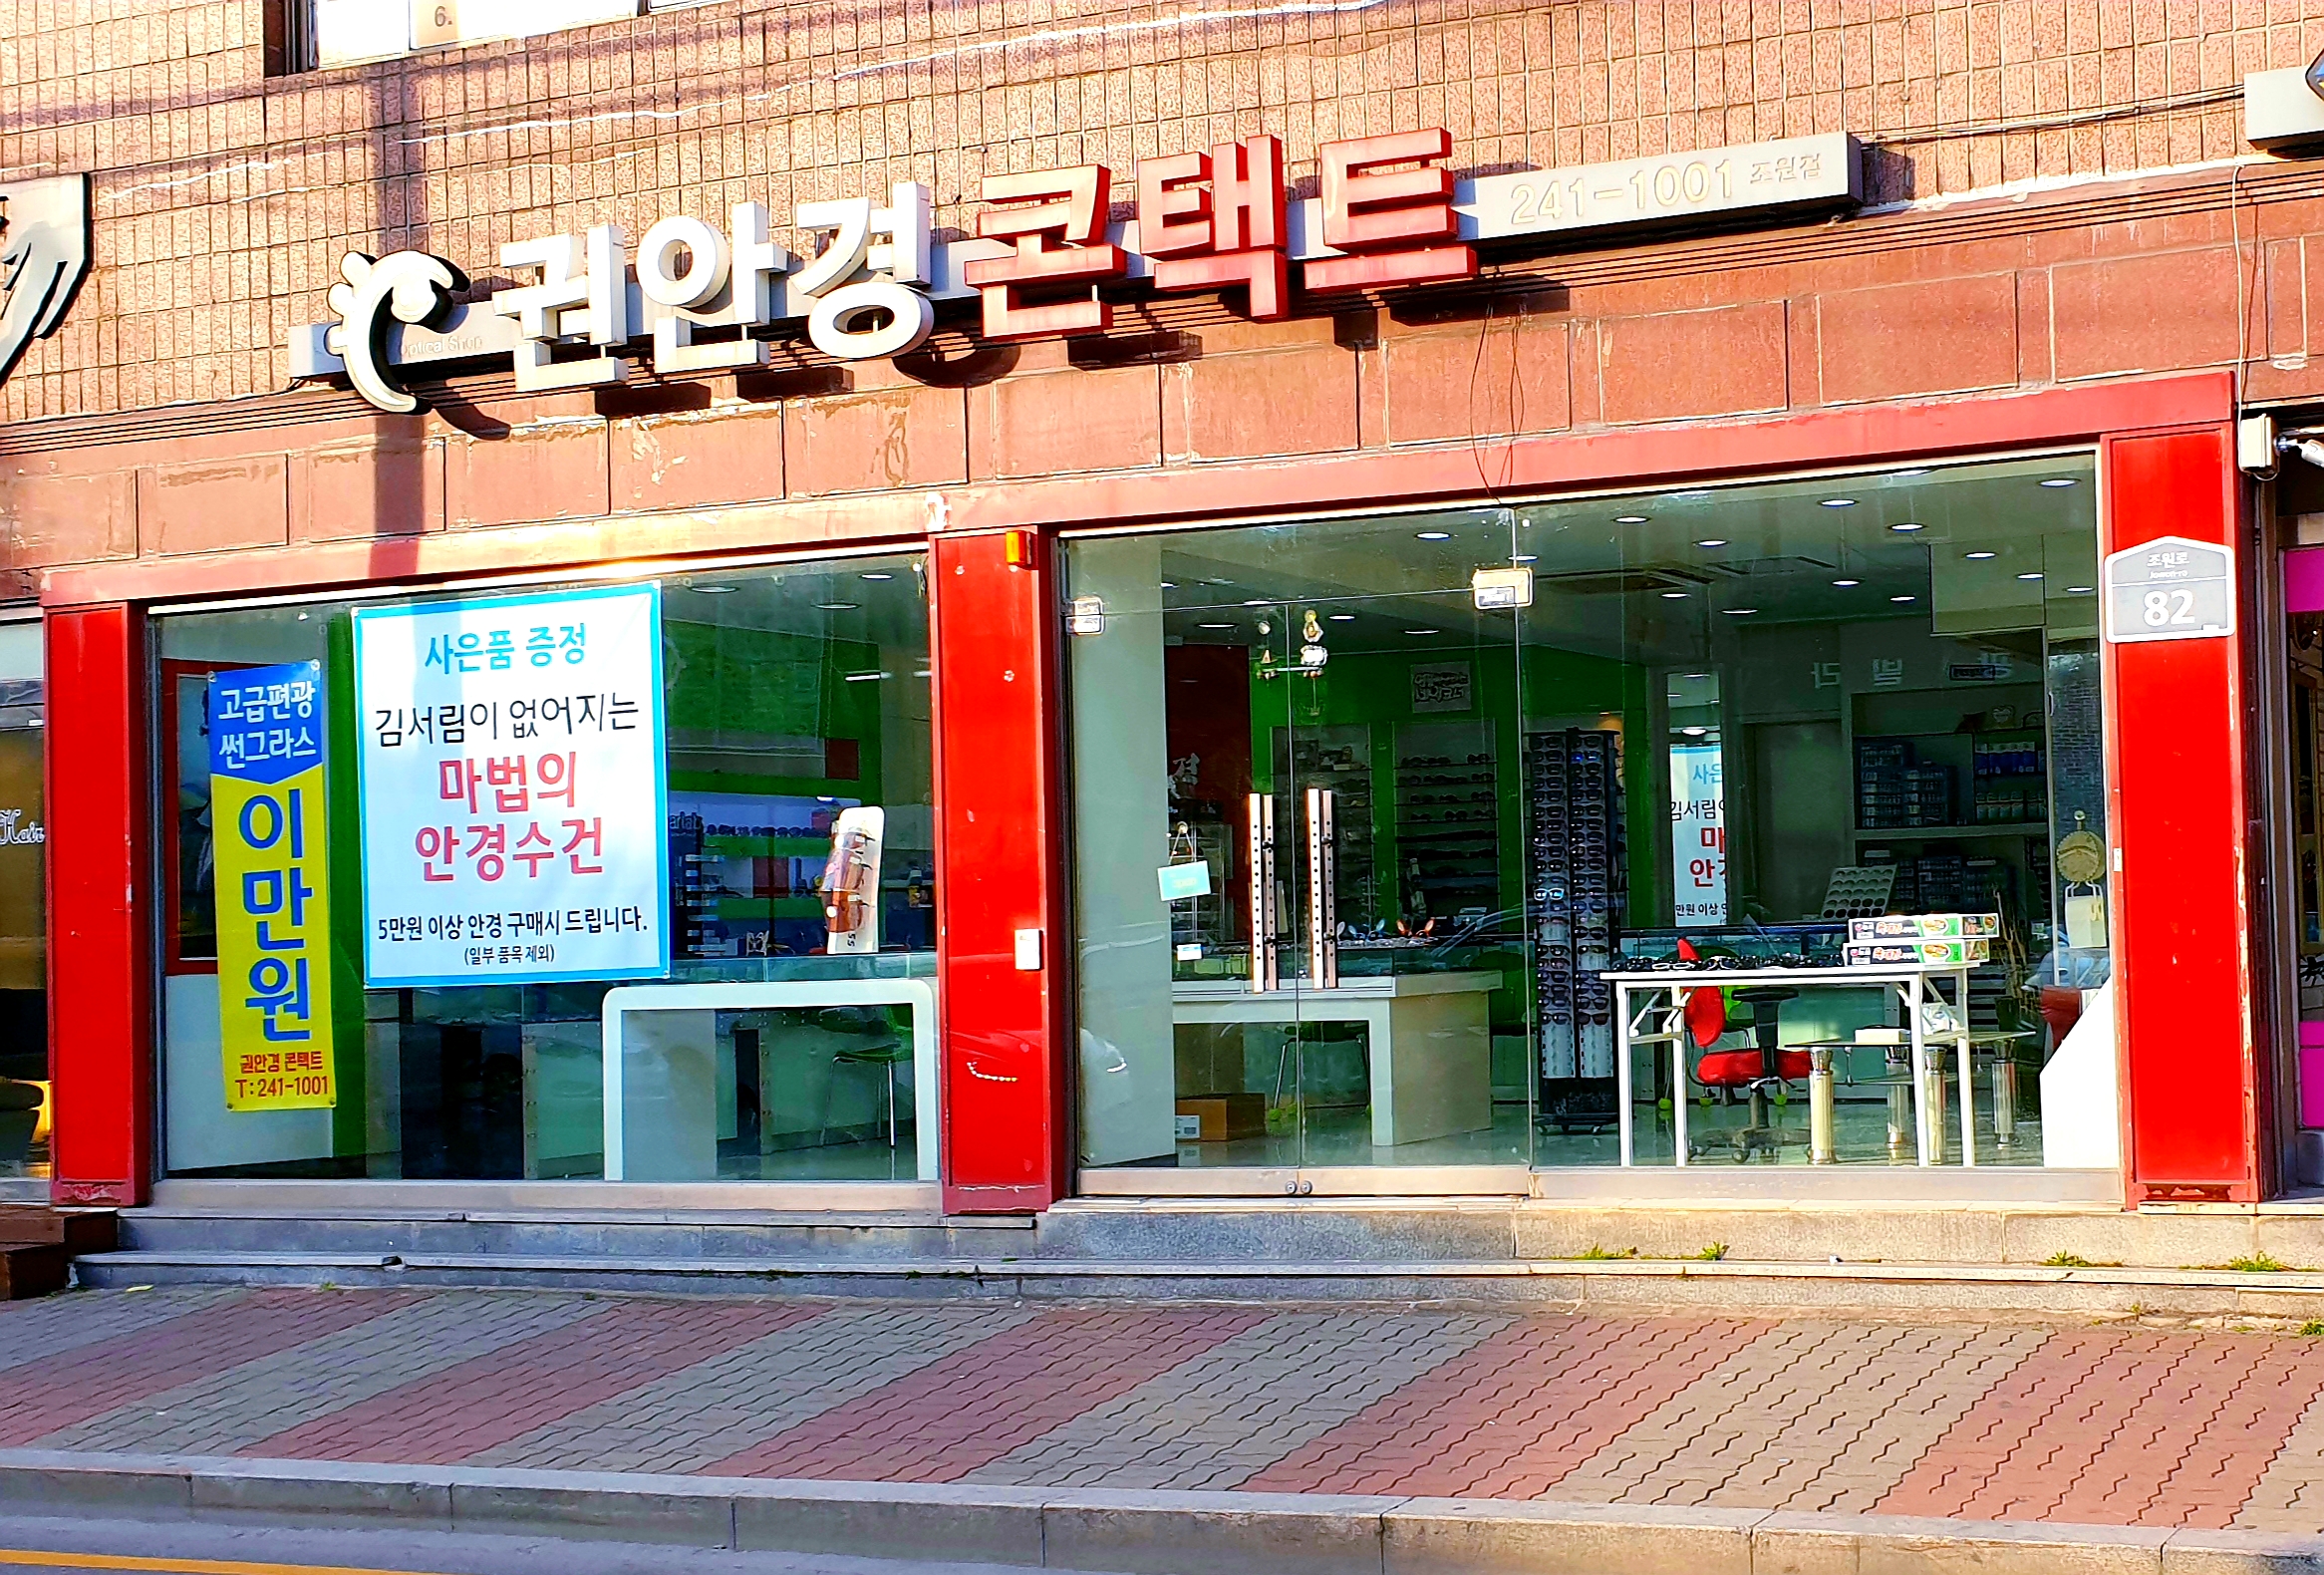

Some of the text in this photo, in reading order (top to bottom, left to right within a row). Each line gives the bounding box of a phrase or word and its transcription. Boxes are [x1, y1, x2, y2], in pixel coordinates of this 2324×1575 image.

[1510, 158, 1734, 225] 241-1001
[492, 127, 1477, 392] 권안경 콘택트
[2146, 551, 2190, 569] 조원로
[2143, 588, 2195, 627] 82
[425, 622, 586, 675] 사은품 증정
[218, 680, 317, 724] 고급편광
[375, 692, 639, 748] 김서림이 없어지는
[218, 726, 317, 770] 썬그라스
[438, 751, 577, 814] 마법의
[415, 816, 603, 882] 안경수건
[238, 788, 313, 1042] 이만원
[378, 905, 648, 942] 5만원 이상 안경 구매시 드립니다.
[463, 943, 555, 966] (일부 품목 제외)
[240, 1053, 280, 1075] 권안경
